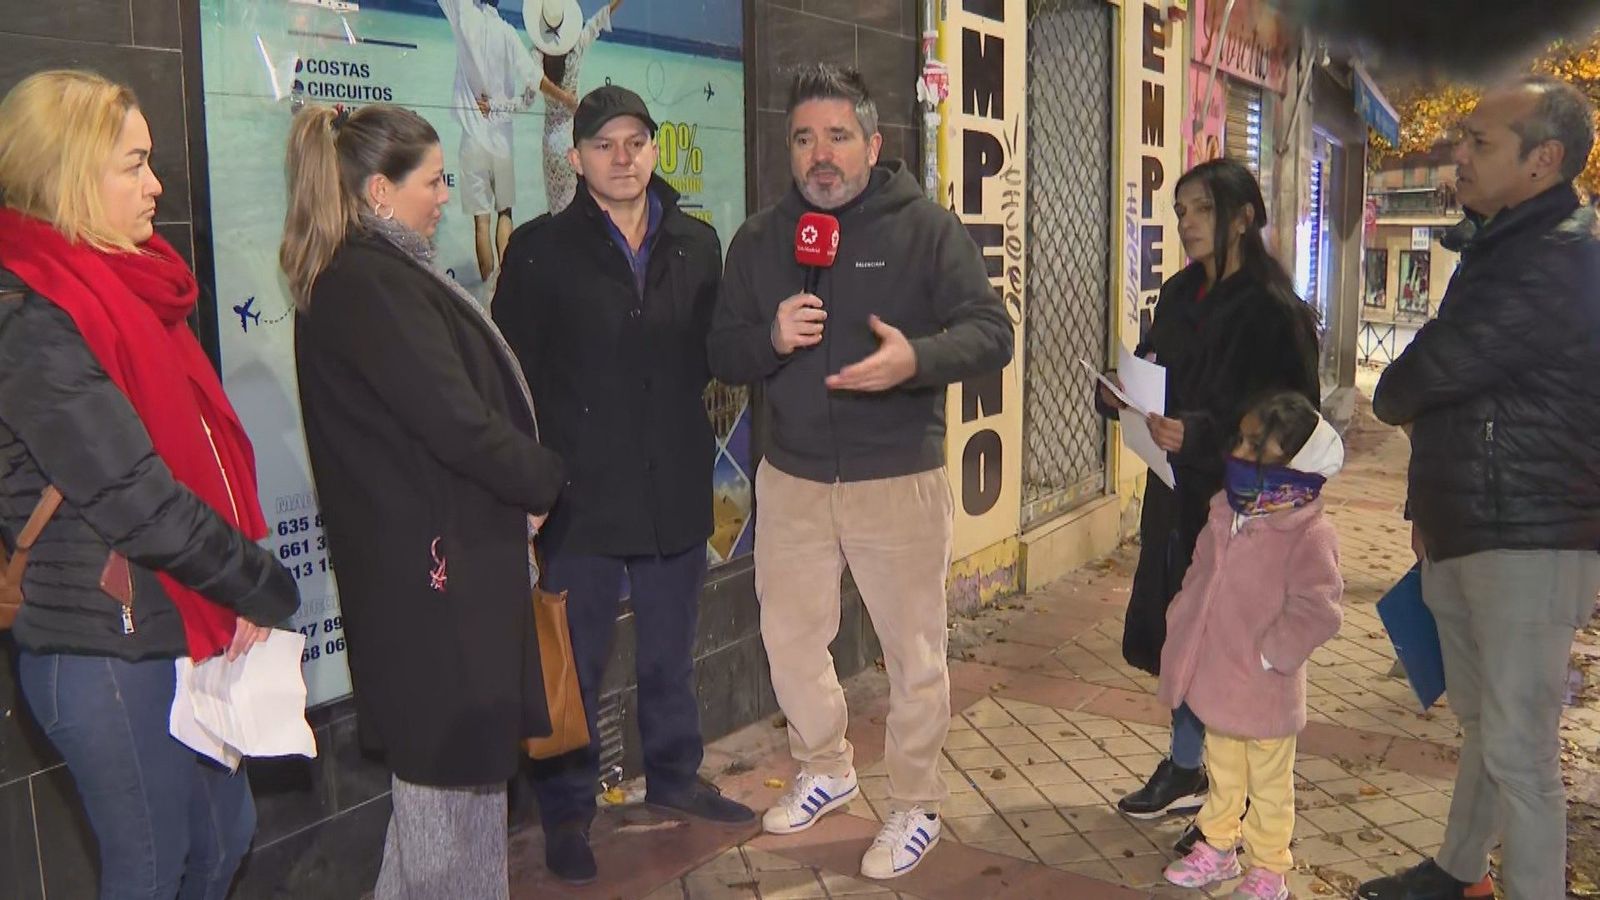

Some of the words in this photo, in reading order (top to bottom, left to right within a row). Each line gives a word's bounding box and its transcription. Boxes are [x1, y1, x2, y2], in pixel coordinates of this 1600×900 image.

[306, 58, 371, 79] COSTAS
[307, 81, 394, 102] CIRCUITOS
[277, 516, 310, 537] 635
[279, 538, 310, 560] 661
[317, 535, 327, 551] 3
[288, 561, 314, 581] 13
[325, 637, 346, 656] 06
